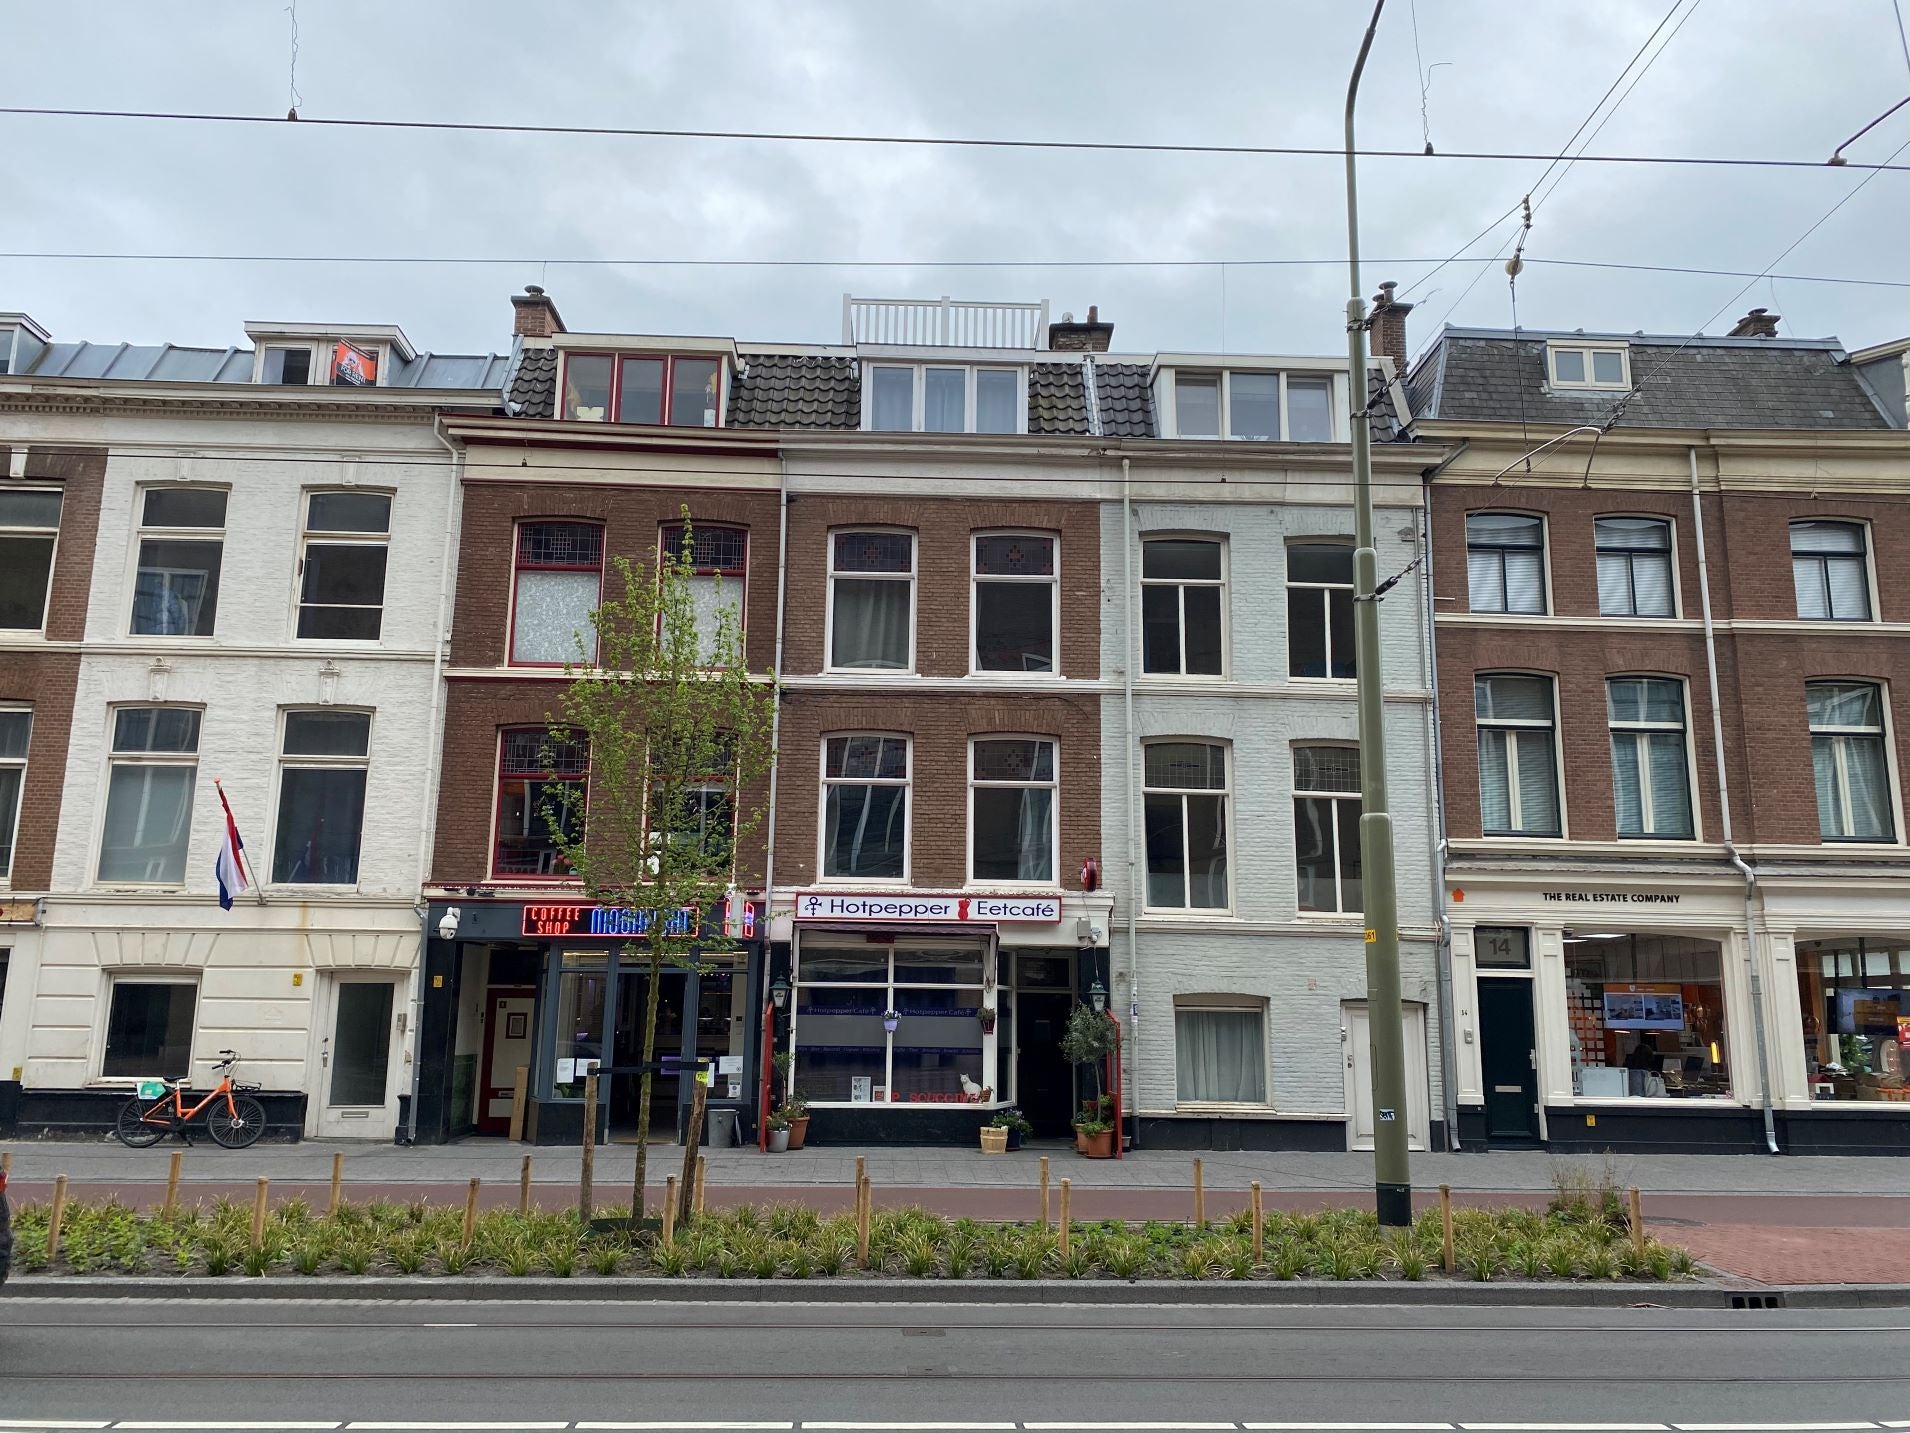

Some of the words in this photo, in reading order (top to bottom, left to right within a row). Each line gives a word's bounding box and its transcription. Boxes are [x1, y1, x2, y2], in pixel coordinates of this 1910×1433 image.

[1543, 892, 1562, 901] THE
[1565, 892, 1590, 902] REAL
[1593, 893, 1628, 902] ESTATE
[1631, 894, 1680, 903] COMPANY
[531, 907, 580, 920] COFFEE
[830, 898, 951, 917] Hotpepper
[977, 900, 1054, 917] Eetcafé
[537, 920, 569, 934] SHOP
[1489, 938, 1511, 955] 14
